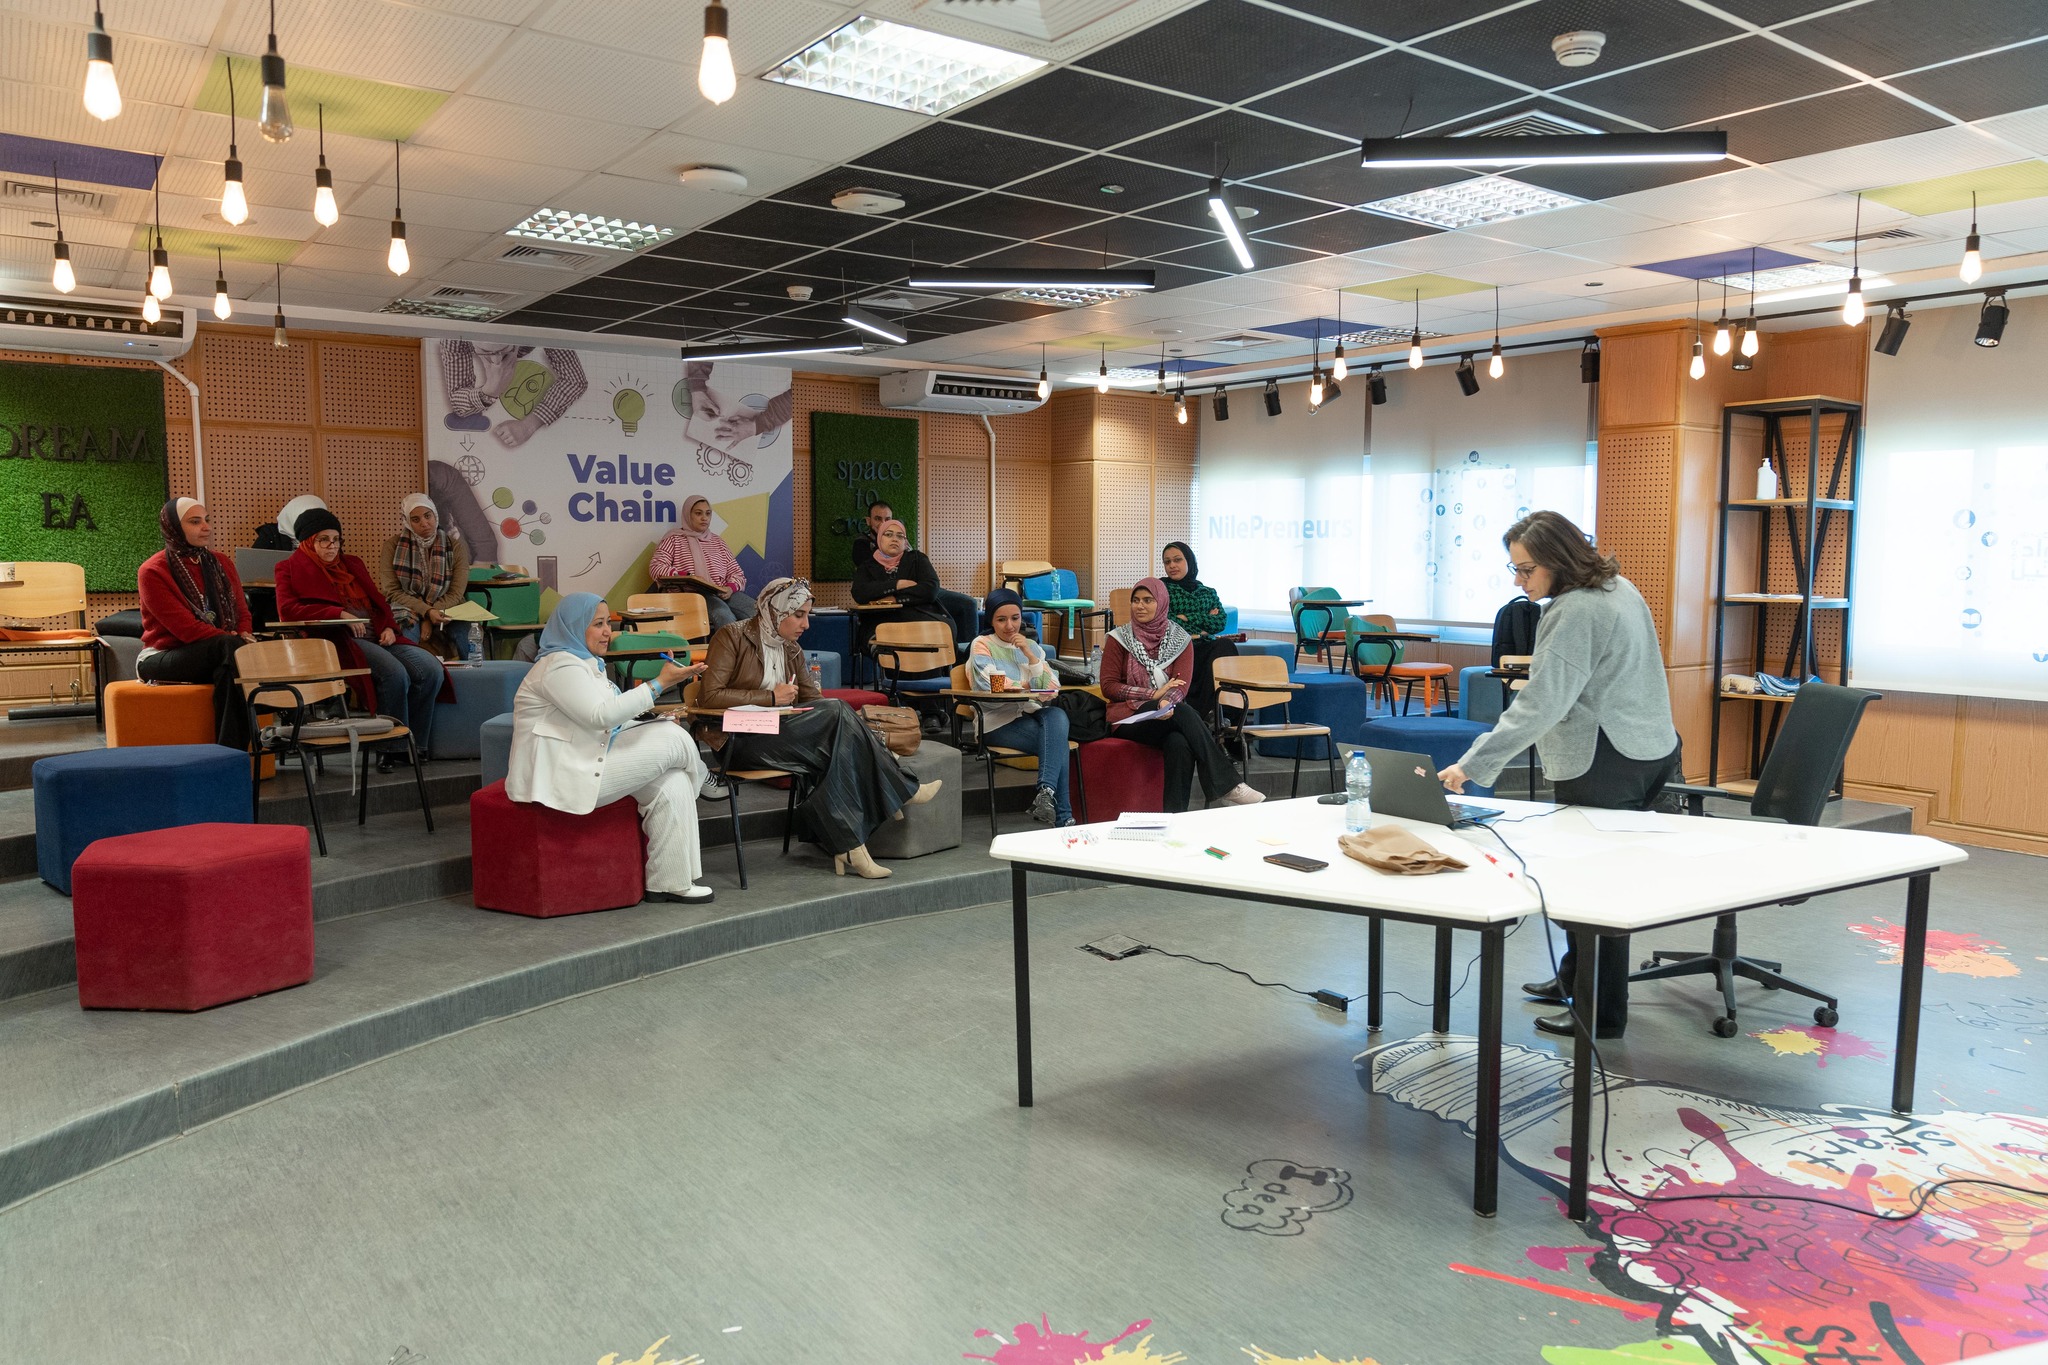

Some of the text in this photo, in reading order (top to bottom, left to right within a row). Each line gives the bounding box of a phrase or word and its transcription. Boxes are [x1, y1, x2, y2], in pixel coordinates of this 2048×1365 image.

[566, 453, 676, 486] Value
[837, 459, 903, 488] space
[40, 491, 98, 530] EA
[568, 489, 677, 523] Chain
[855, 487, 880, 510] to
[1209, 515, 1353, 539] NilePreneurs
